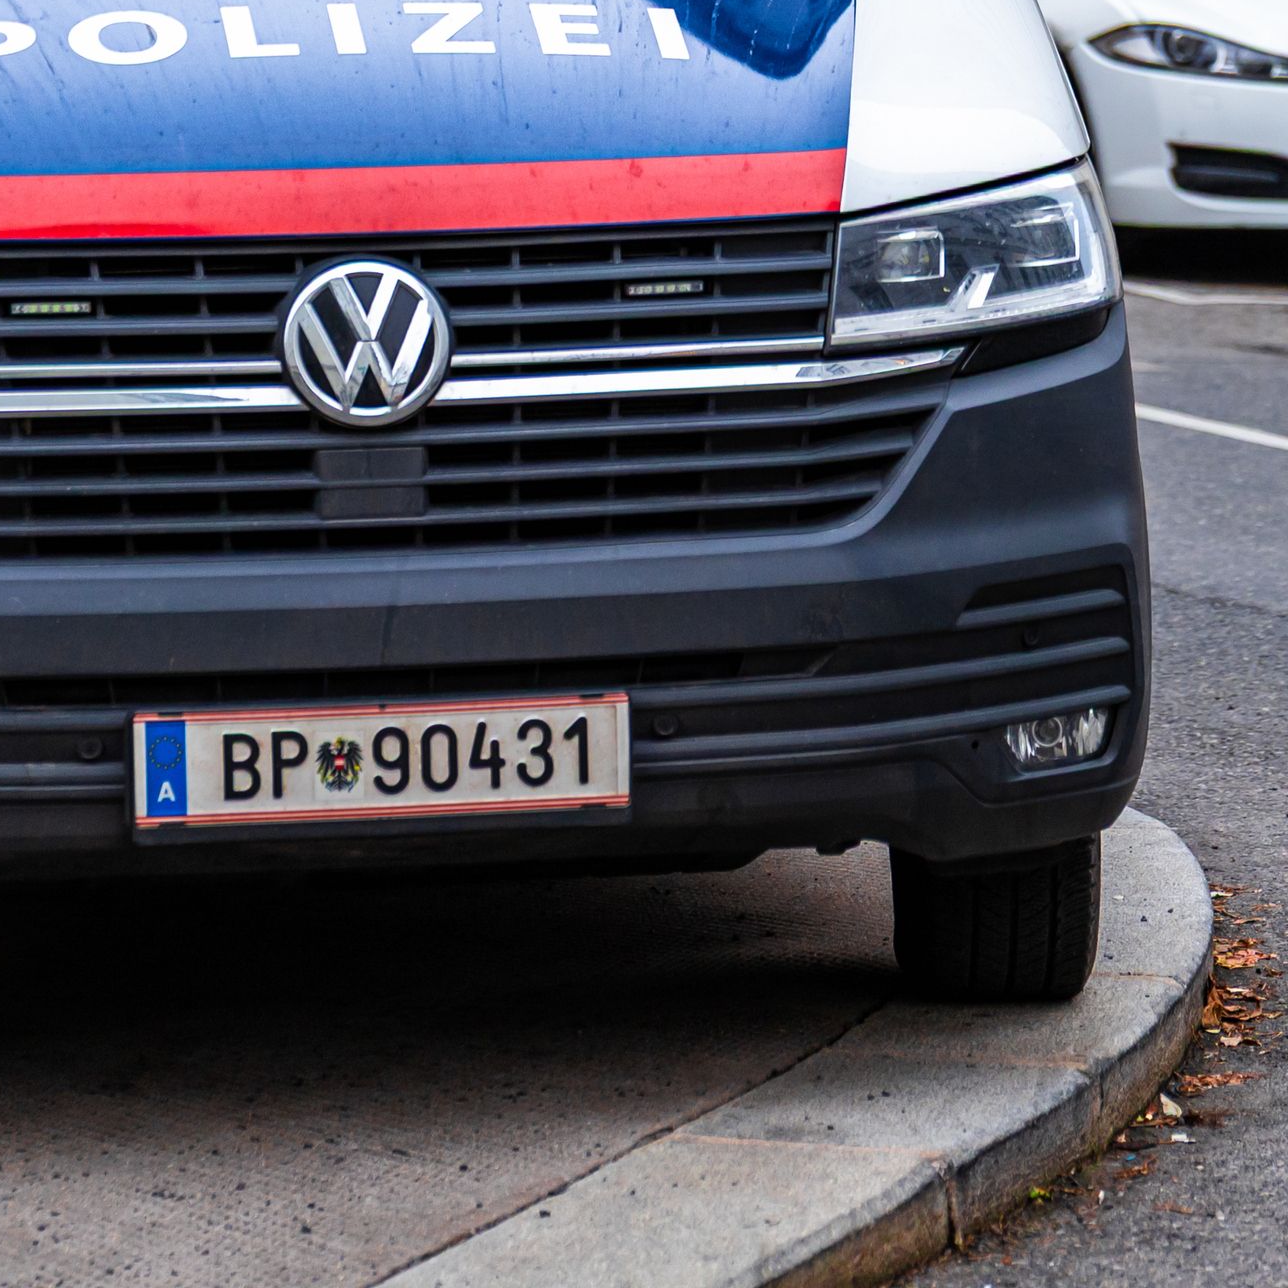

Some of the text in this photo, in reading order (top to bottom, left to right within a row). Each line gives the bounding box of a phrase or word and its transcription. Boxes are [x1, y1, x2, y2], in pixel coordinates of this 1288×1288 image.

[222, 715, 591, 801] BP 90431
[157, 780, 176, 803] A
